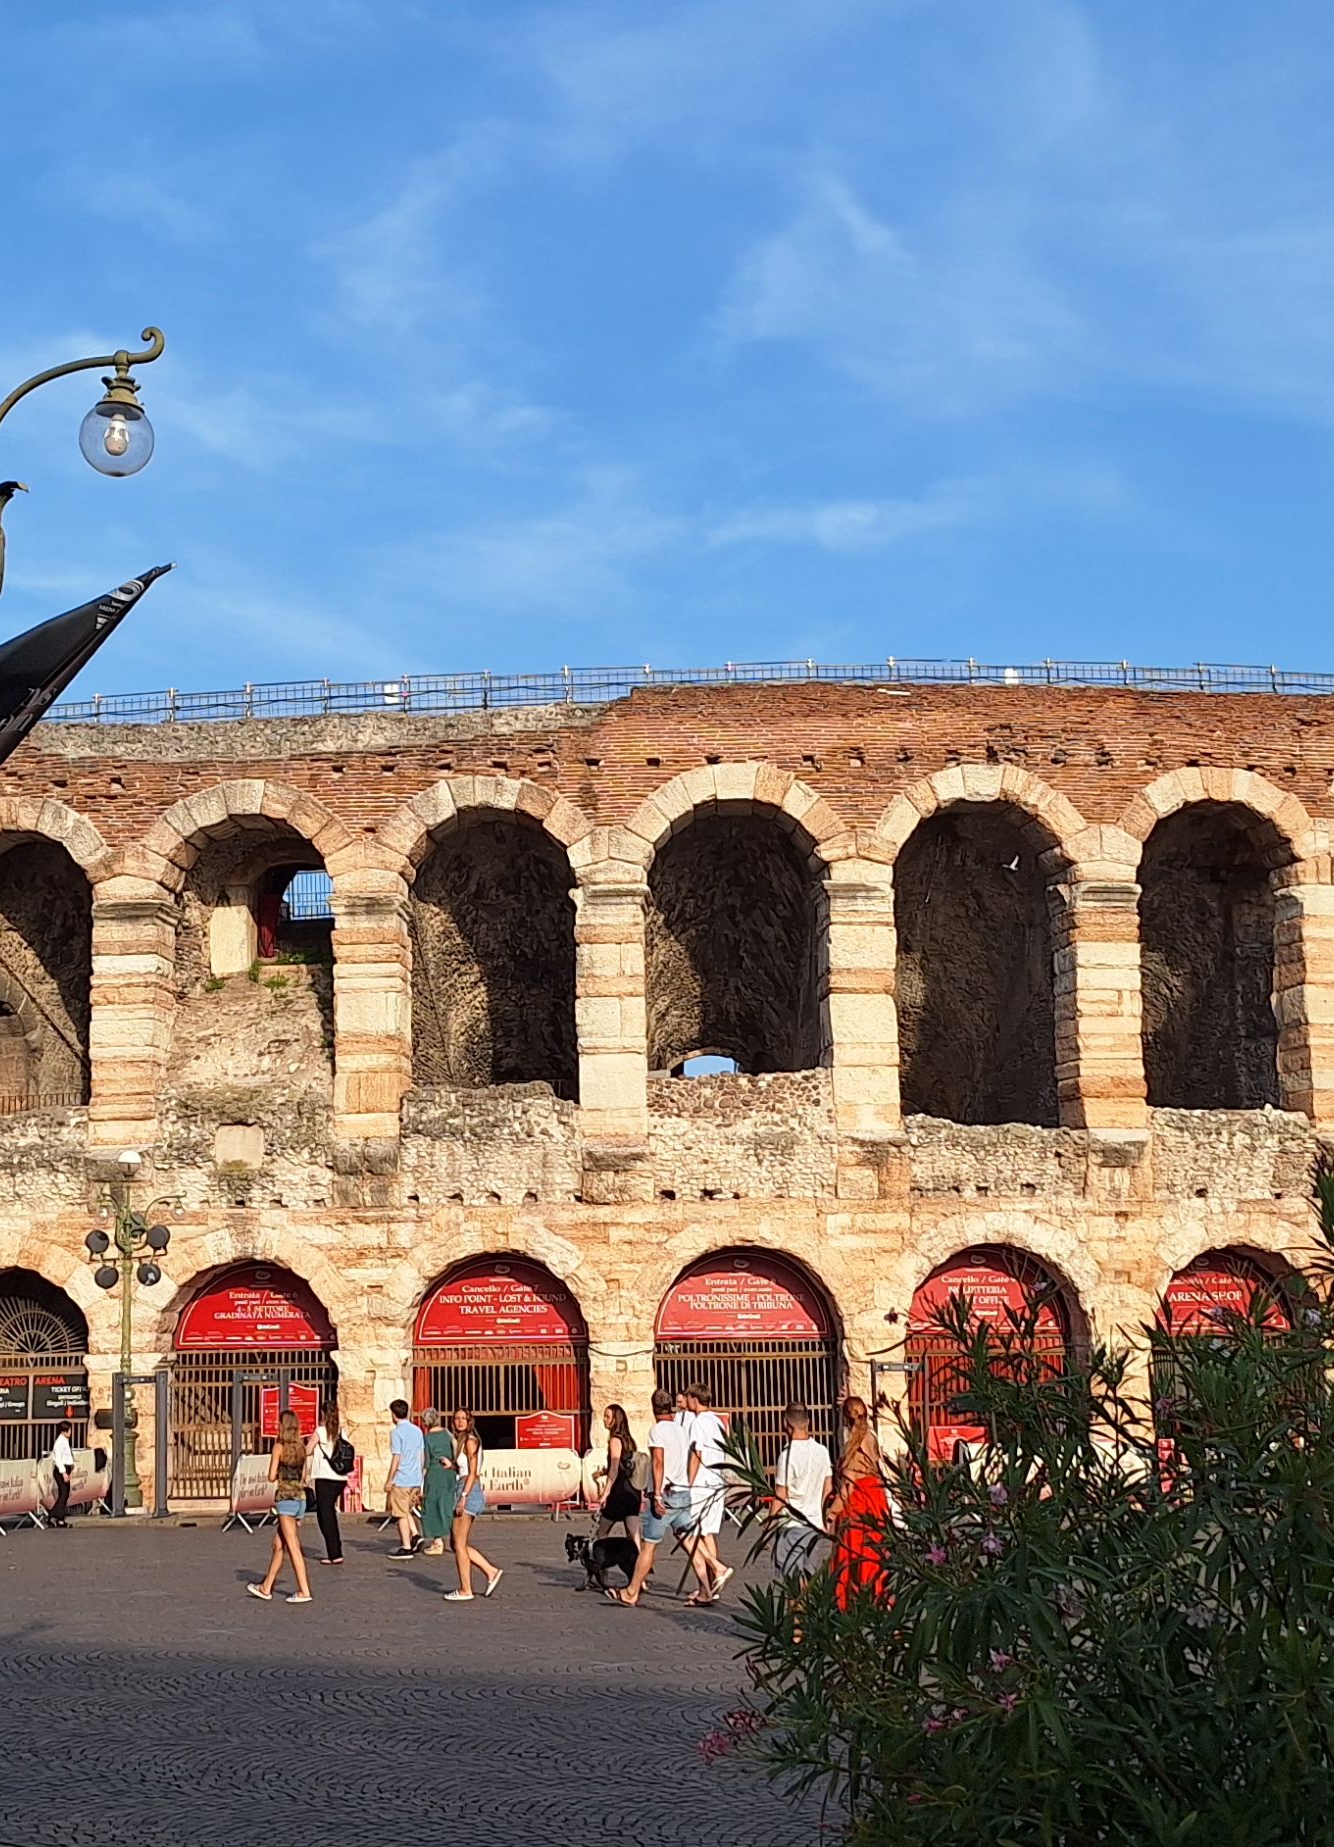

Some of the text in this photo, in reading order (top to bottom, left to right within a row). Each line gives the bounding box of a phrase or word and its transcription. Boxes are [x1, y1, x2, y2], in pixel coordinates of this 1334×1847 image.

[705, 1278, 737, 1286] Entrata
[461, 1284, 501, 1293] Cancello
[229, 1291, 260, 1299] Entrata
[439, 1295, 463, 1304] INFO
[464, 1294, 492, 1304] POINT
[499, 1294, 522, 1303] LOST
[678, 1293, 749, 1303] POLTRONISSIME
[1168, 1291, 1211, 1302] ARENA
[459, 1304, 548, 1314] TRAVEL AGENCIES
[690, 1301, 739, 1310] POLTRONE
[753, 1301, 794, 1310] TRIBUNA
[213, 1311, 311, 1320] GRADINATA NUMERATA
[34, 1375, 65, 1385] ARENA
[492, 1466, 532, 1478] Italian
